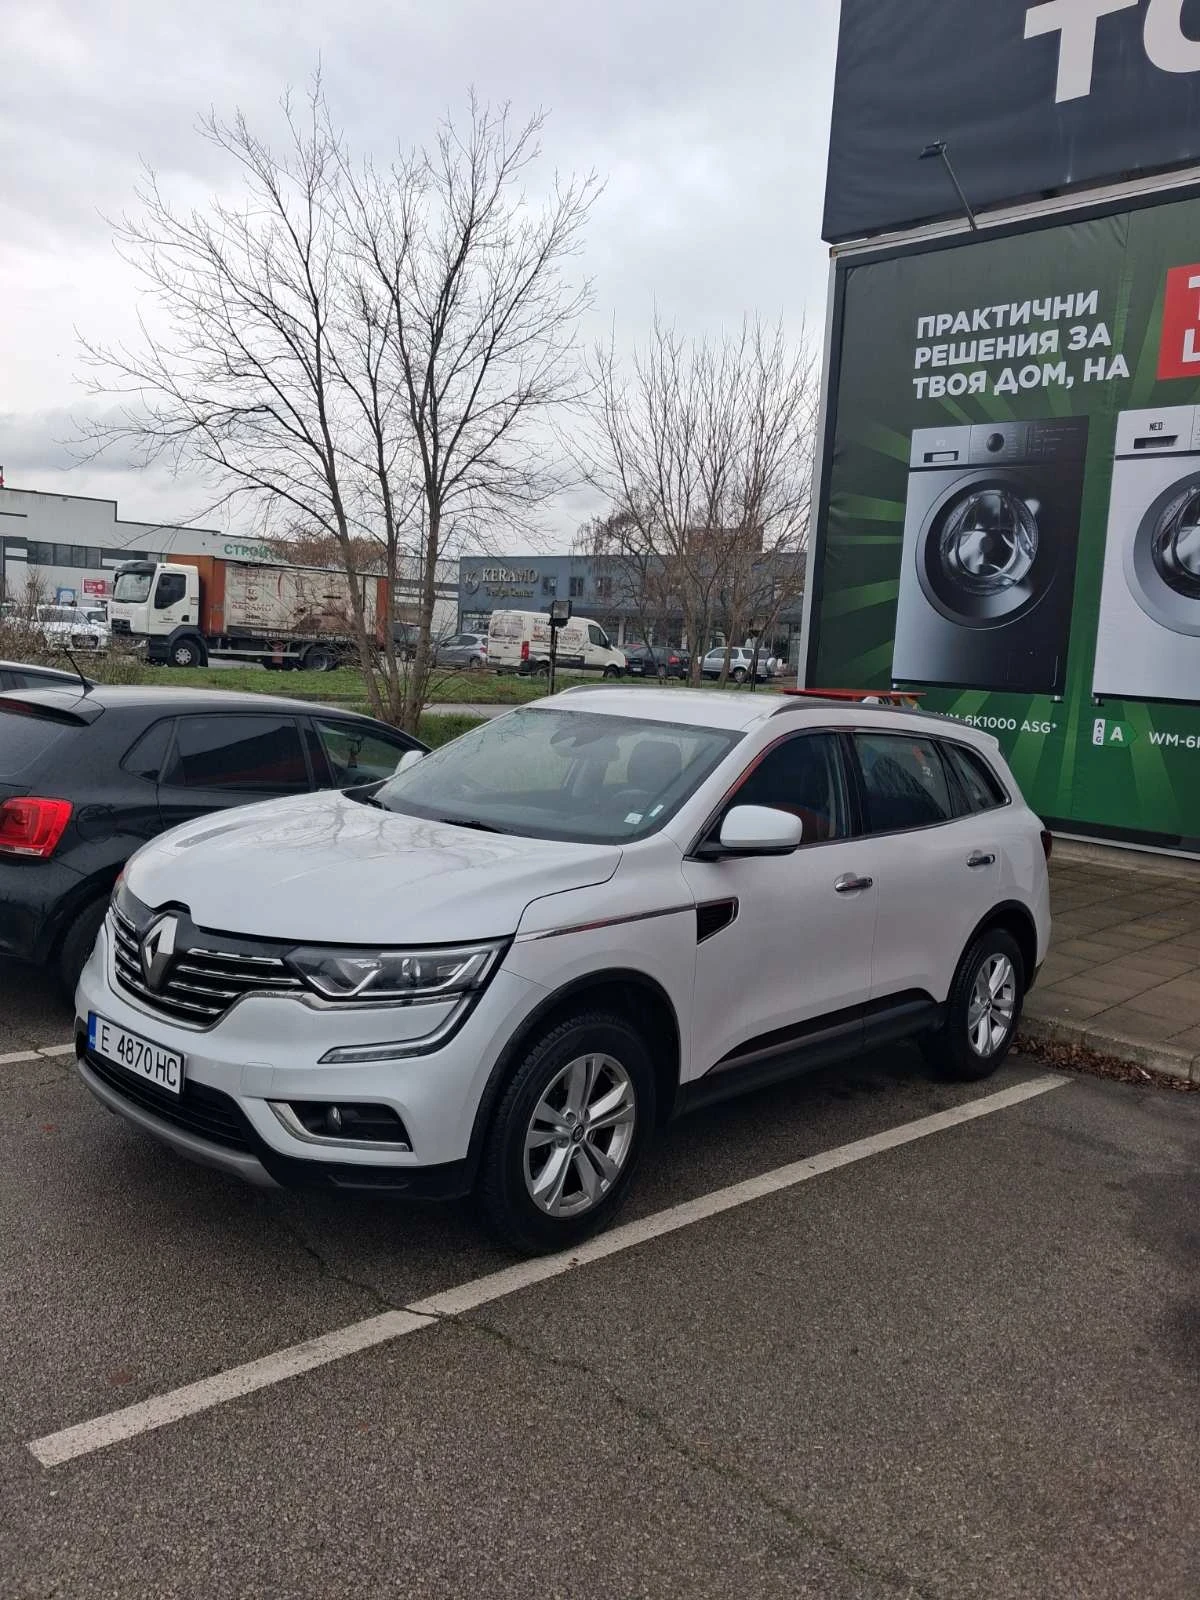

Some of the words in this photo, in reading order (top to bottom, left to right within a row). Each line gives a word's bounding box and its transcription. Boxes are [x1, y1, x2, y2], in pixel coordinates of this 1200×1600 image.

[917, 289, 1099, 339] ПРАКТИЧНИ
[914, 329, 1059, 369] РЕШЕНИЯ
[1068, 322, 1112, 351] ЗА
[913, 370, 987, 400] ТВОЯ
[993, 361, 1075, 396] ДОМ,
[1083, 353, 1130, 383] НА
[482, 568, 538, 583] KERAMO
[101, 1025, 110, 1053] E
[117, 1034, 152, 1074] 4870
[156, 1052, 178, 1087] HC
